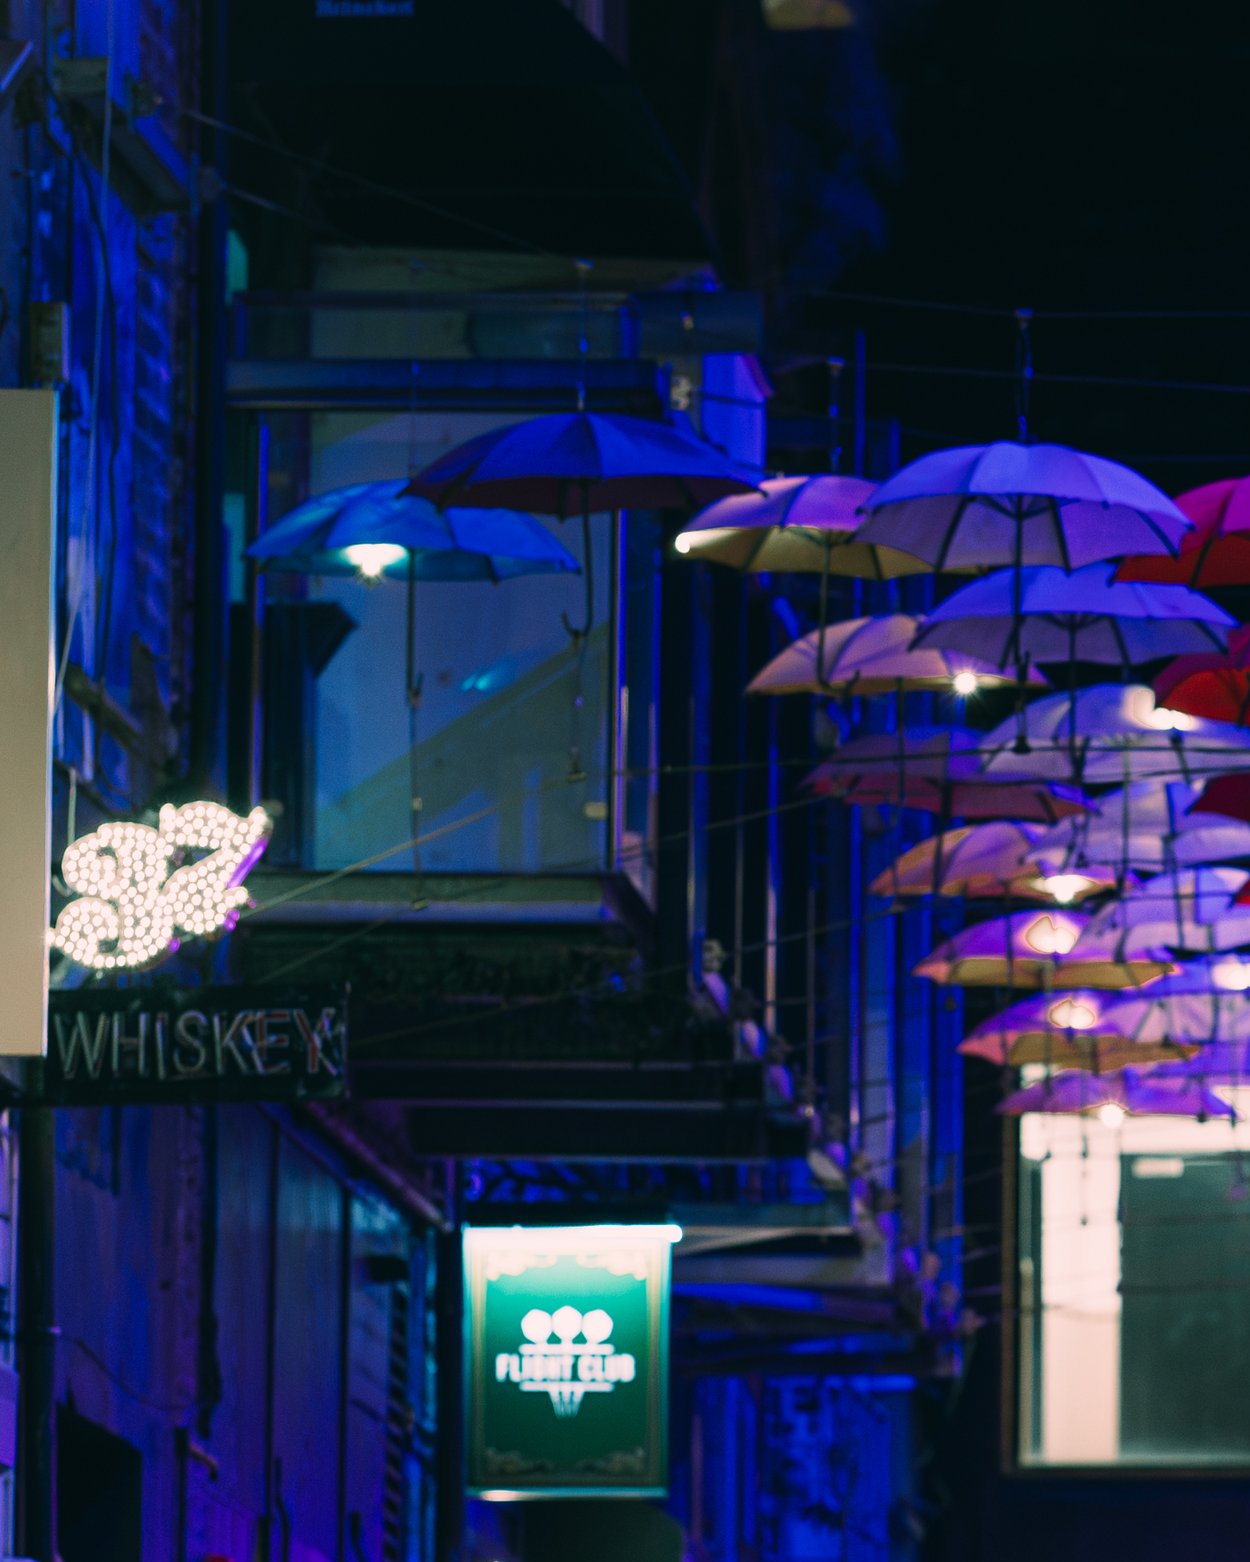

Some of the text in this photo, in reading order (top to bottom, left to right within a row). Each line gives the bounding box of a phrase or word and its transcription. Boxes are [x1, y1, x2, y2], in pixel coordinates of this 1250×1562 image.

[46, 800, 272, 972] 37
[54, 1007, 335, 1080] WHISKEY
[577, 1353, 636, 1383] CLUB
